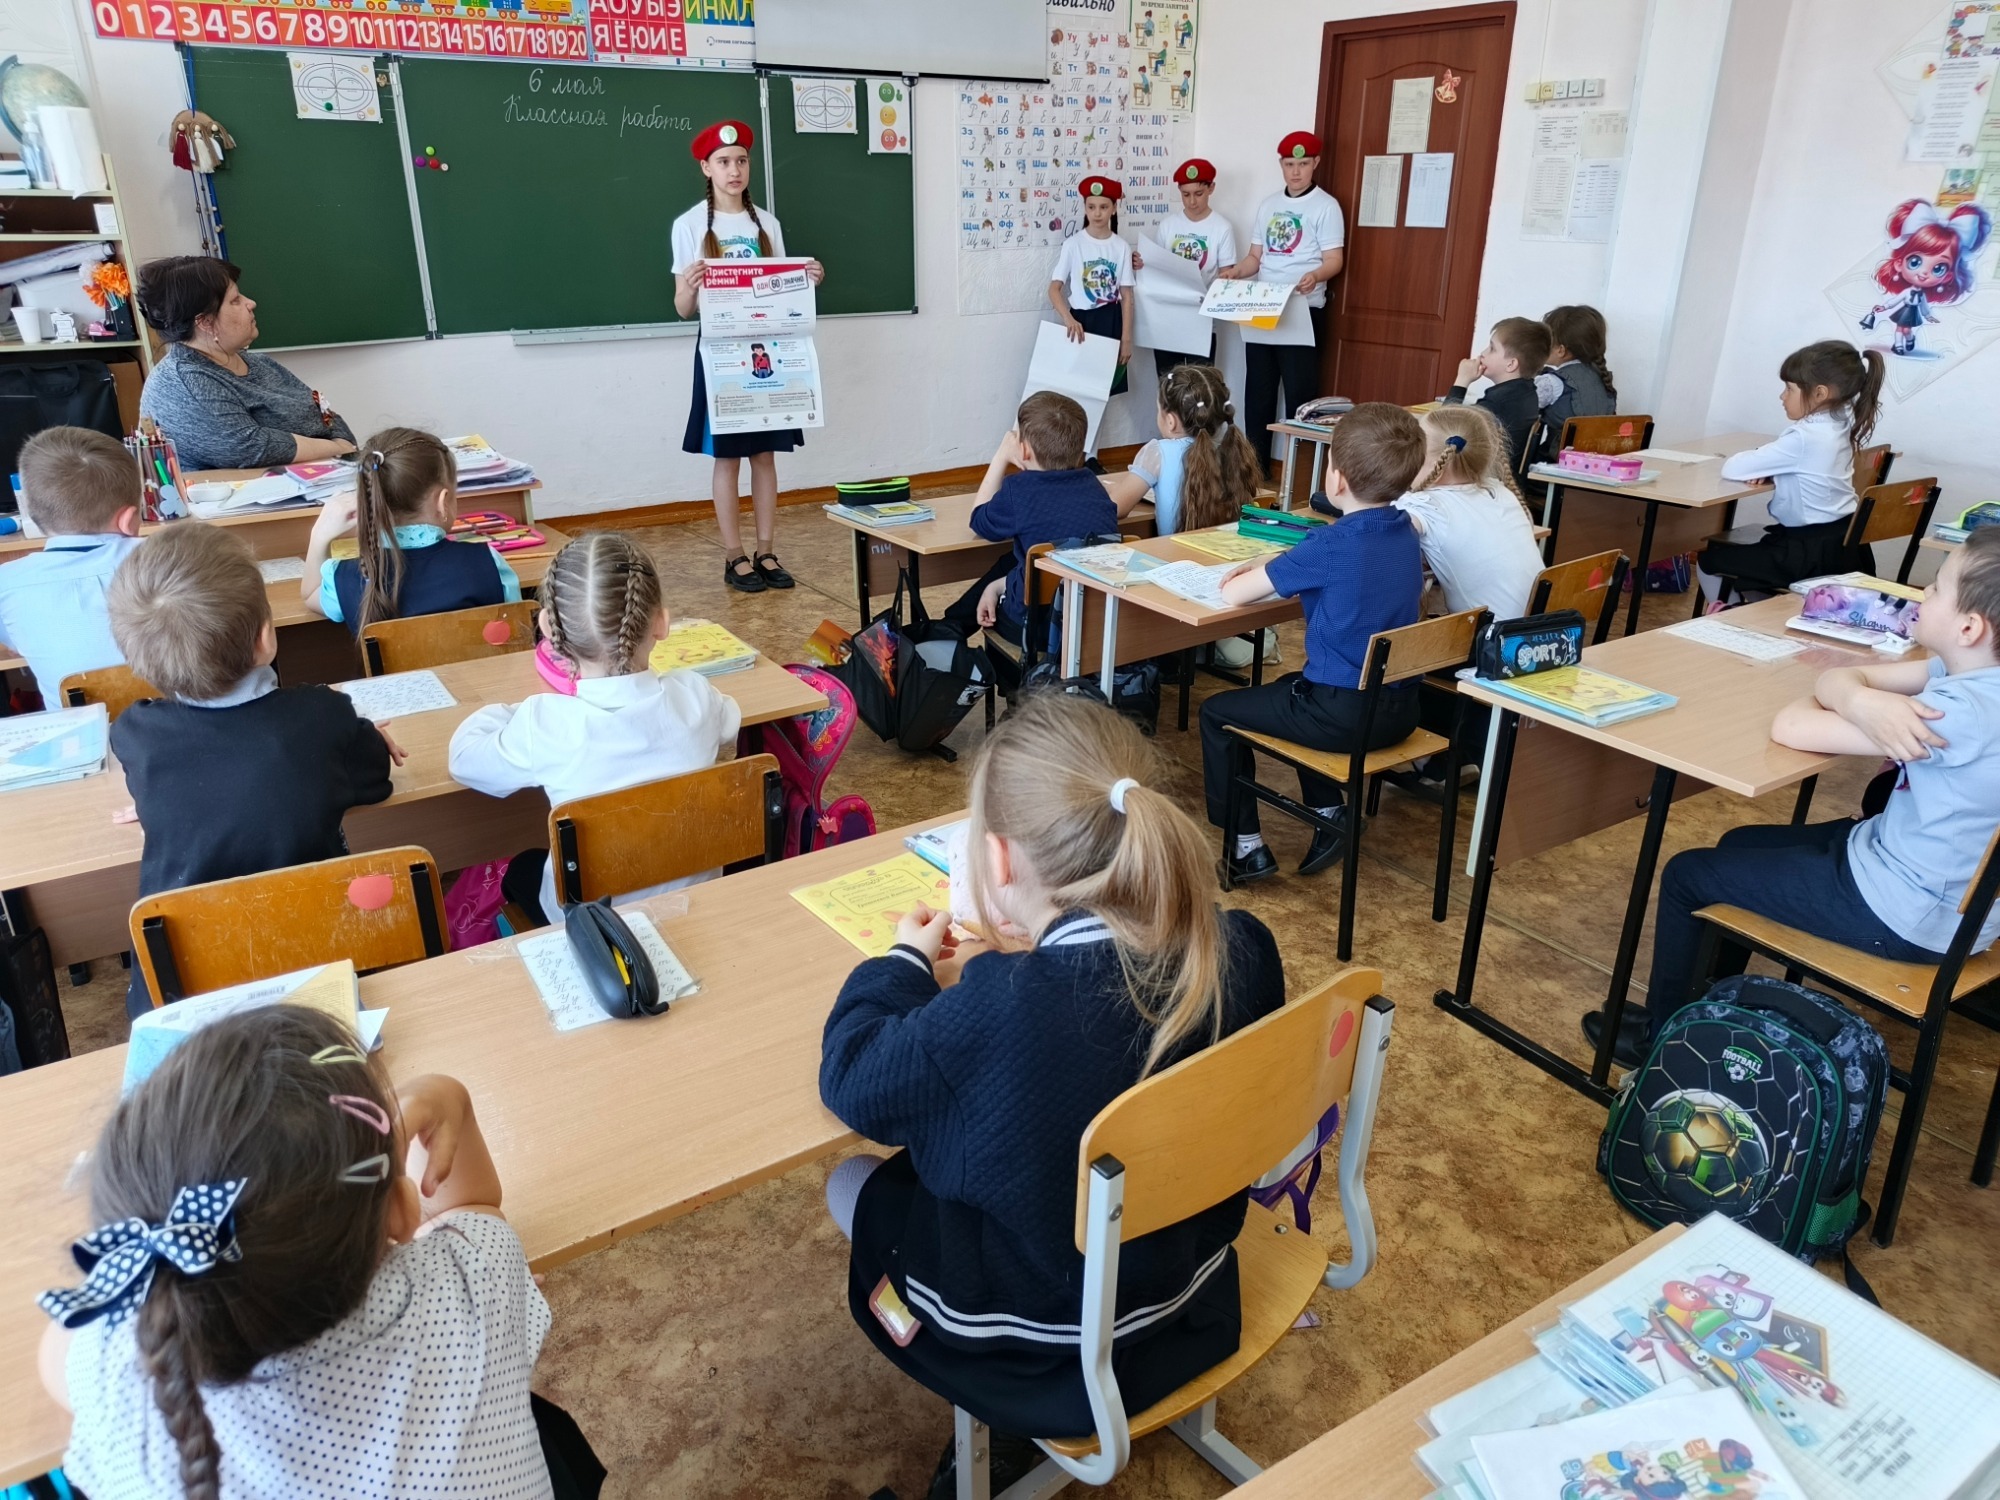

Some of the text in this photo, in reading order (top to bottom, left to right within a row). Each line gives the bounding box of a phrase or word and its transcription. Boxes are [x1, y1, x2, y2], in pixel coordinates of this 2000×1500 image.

[96, 3, 588, 56] 0 1 2 3 4 5 6 7 8 9 10 11 12 13 14 15 16 17 18 19 20
[529, 68, 606, 95] 6 мая
[503, 94, 692, 138] Классная работа
[706, 267, 764, 277] Пристегните
[706, 276, 738, 287] ремни!
[771, 278, 780, 289] 60
[1518, 642, 1559, 669] SPORT
[1722, 1048, 1761, 1074] FOOTBALL
